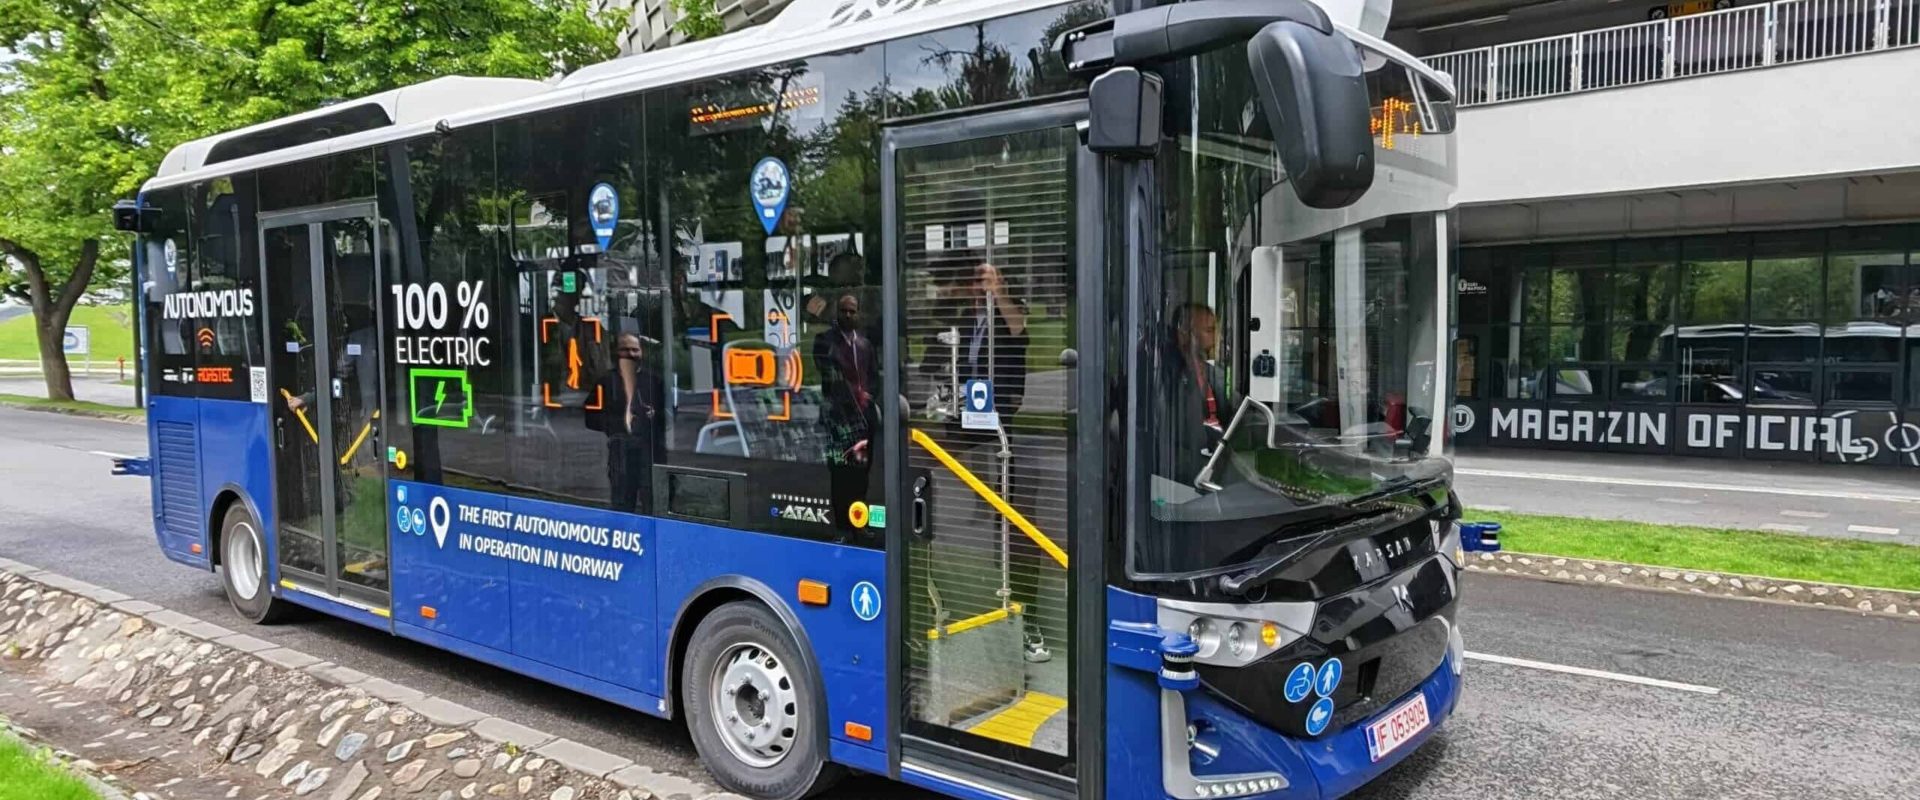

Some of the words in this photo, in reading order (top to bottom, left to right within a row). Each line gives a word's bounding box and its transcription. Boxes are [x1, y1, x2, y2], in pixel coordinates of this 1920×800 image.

[163, 288, 253, 319] AUTONOMOUS
[392, 281, 448, 330] 100
[457, 280, 489, 329] %
[396, 336, 490, 366] ELECTRIC
[1491, 407, 1666, 445] MAGAZIN
[1687, 413, 1868, 453] OFICIAL
[458, 504, 480, 525] THE
[482, 508, 513, 529] FIRST
[514, 514, 609, 547] AUTONOMOUS
[612, 530, 644, 557] BUS,
[770, 504, 830, 524] e-ATAK
[459, 533, 472, 550] IN
[474, 537, 541, 565] OPERATION
[544, 550, 558, 568] IN
[561, 553, 623, 581] NORWAY
[1391, 700, 1426, 742] 053909
